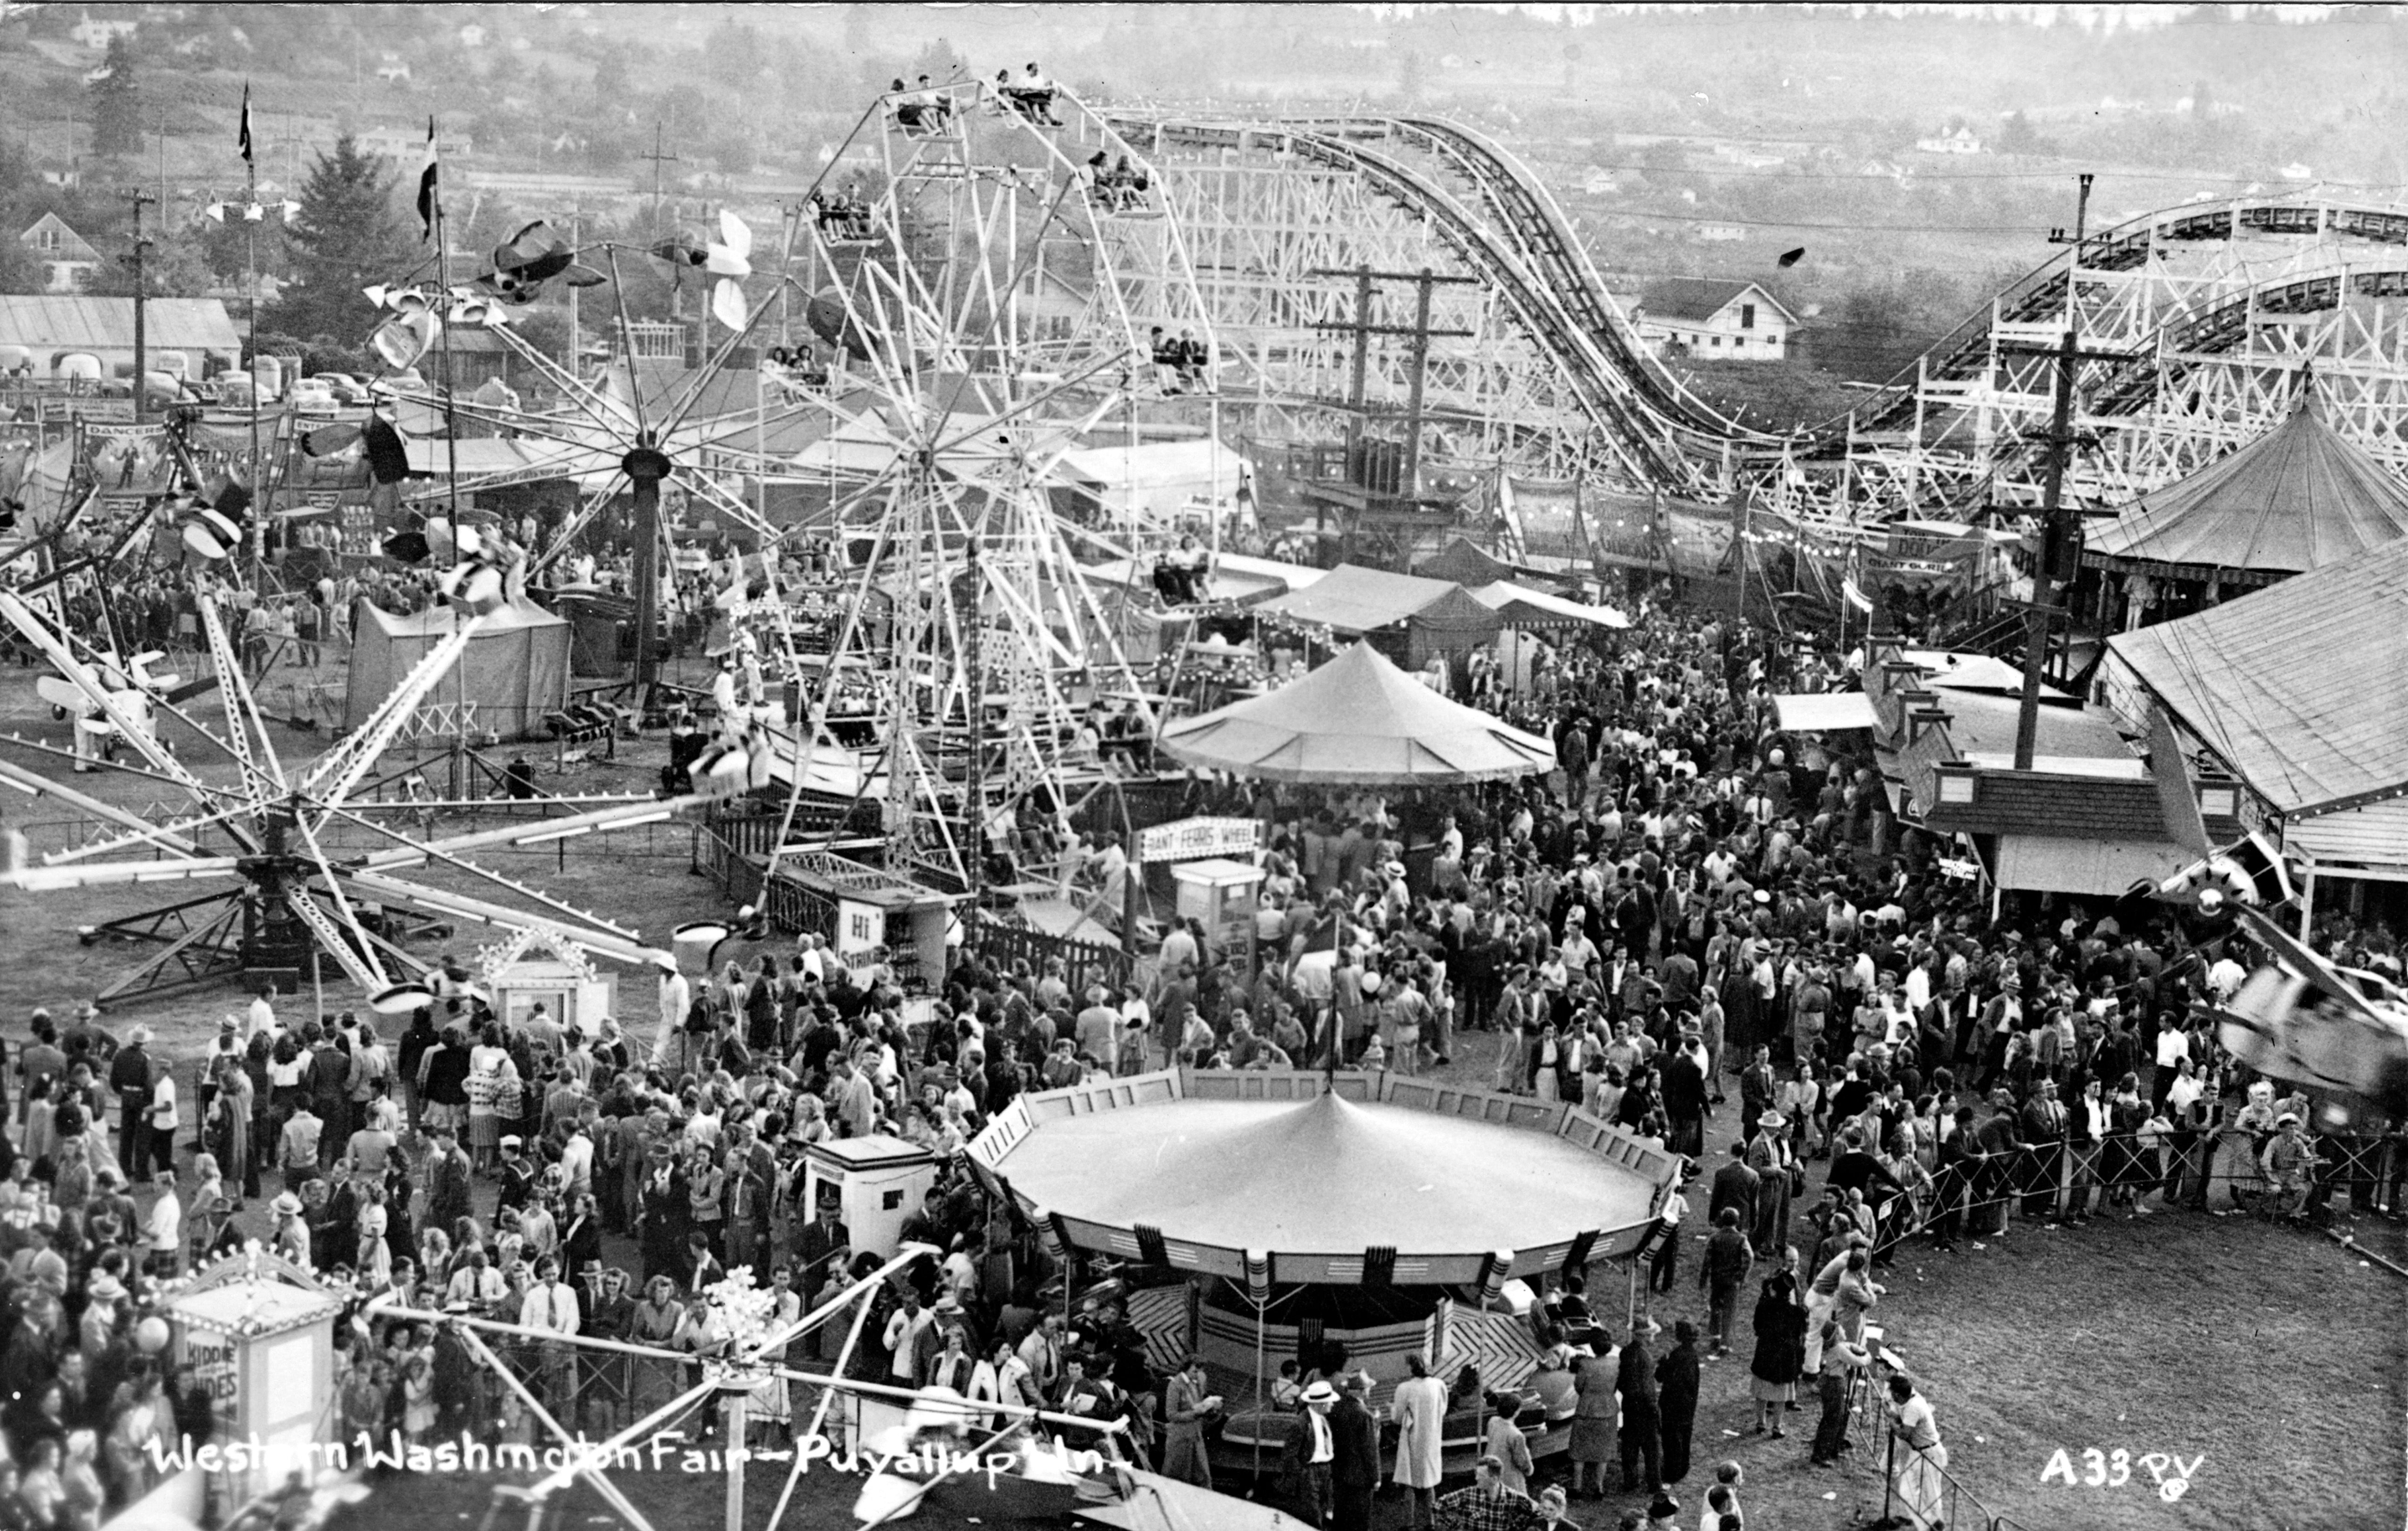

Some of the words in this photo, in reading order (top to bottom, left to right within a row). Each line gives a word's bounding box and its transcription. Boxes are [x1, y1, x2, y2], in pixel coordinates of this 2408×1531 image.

[90, 425, 163, 434] DANCERS
[1868, 558, 1905, 568] GIANT
[1181, 826, 1214, 848] FERRIS
[1221, 827, 1251, 844] WHEEL
[852, 913, 869, 940] Hi
[187, 1341, 236, 1367] KIDDIE
